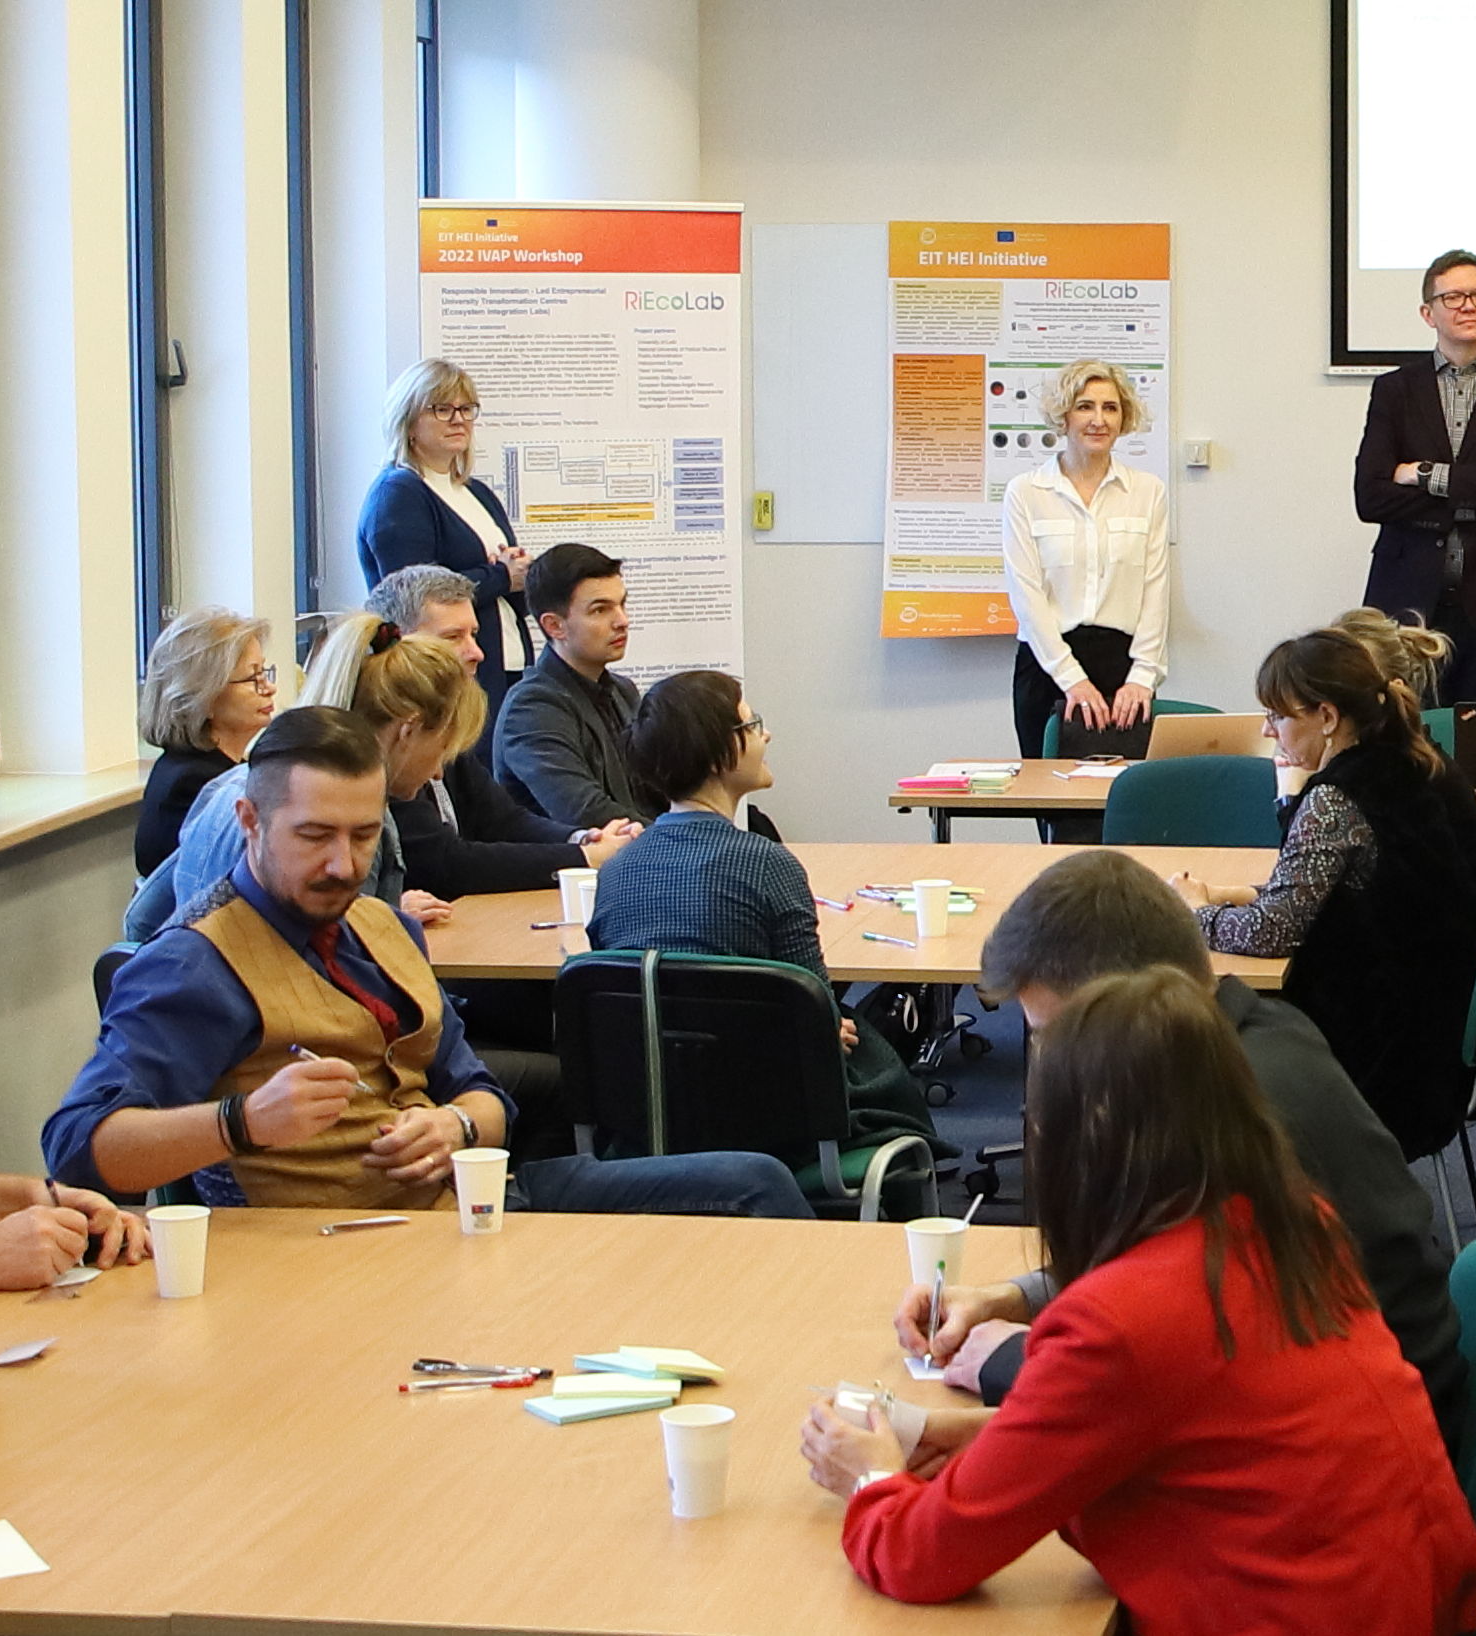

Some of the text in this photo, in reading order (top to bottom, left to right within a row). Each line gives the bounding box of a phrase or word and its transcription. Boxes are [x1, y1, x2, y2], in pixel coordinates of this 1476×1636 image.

[438, 232, 519, 243] EIT HEI Initiative
[438, 249, 583, 265] 2022 IVAP Workshop
[919, 251, 1048, 266] EIT HEI Initiative
[1045, 281, 1138, 300] RiEcoLab
[624, 290, 725, 311] RiEcoLab
